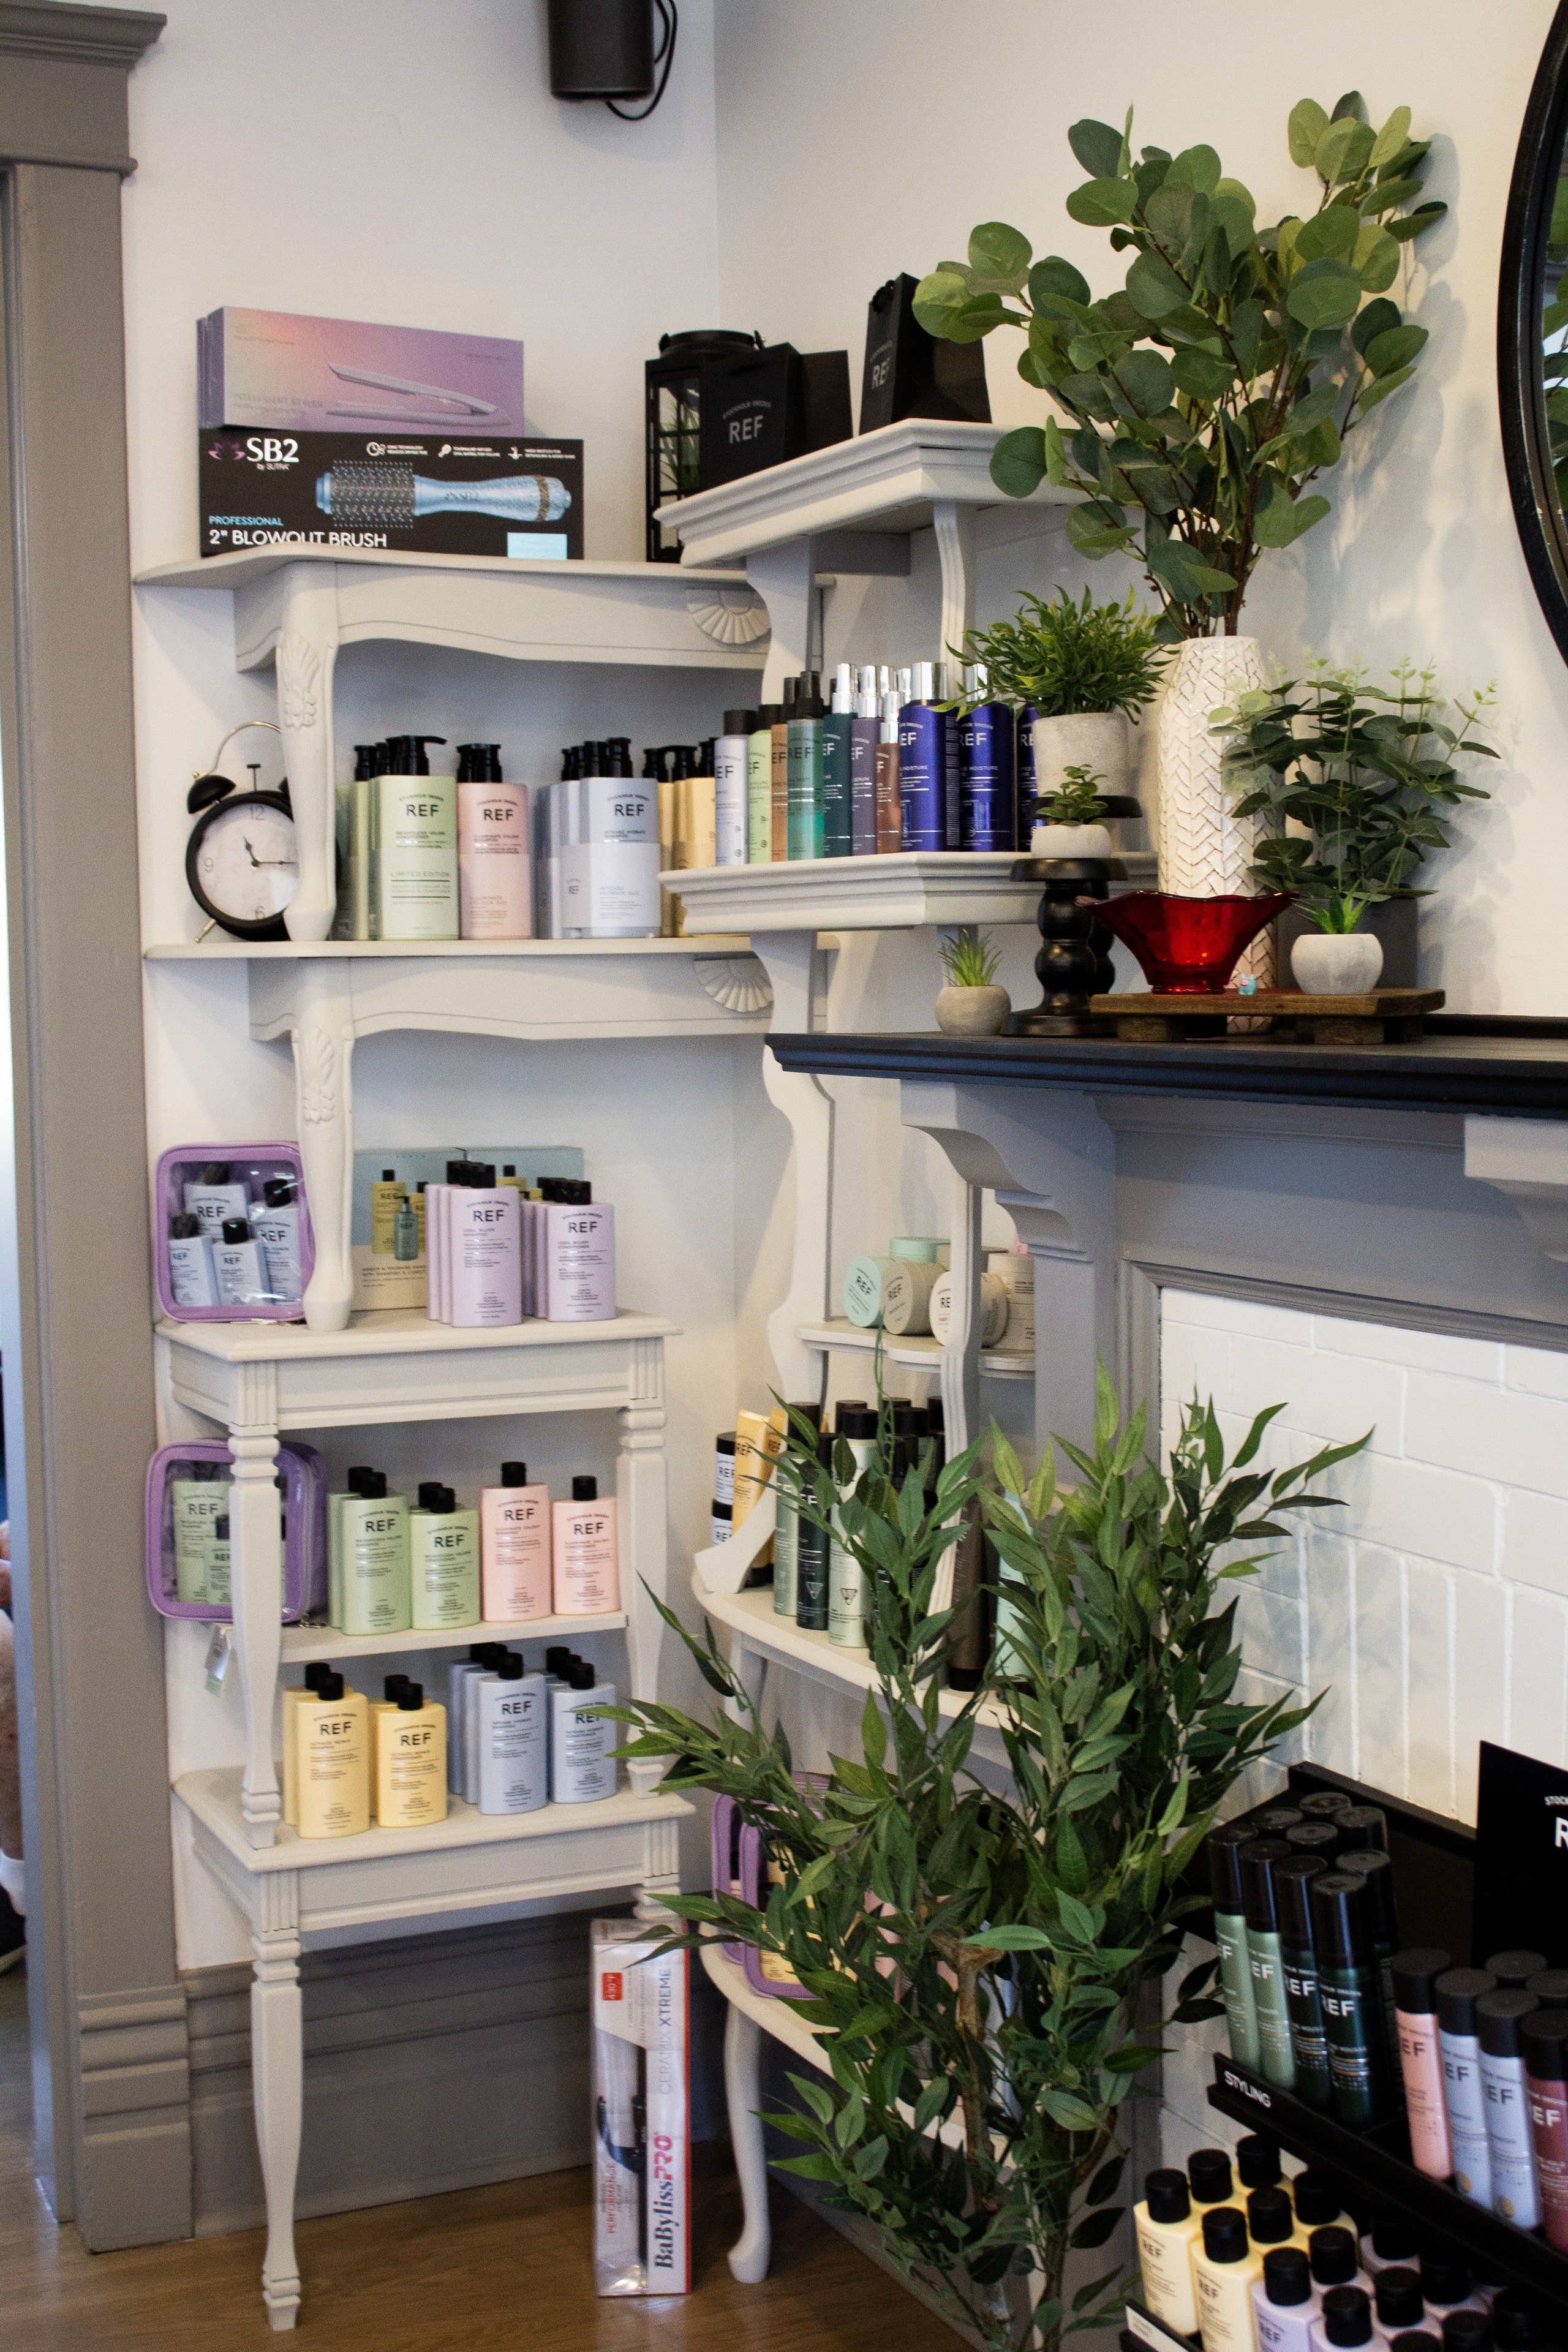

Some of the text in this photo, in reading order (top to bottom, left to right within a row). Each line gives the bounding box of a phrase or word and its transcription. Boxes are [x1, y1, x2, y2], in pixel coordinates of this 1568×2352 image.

[729, 415, 764, 444] REF
[246, 437, 300, 462] SB2
[208, 515, 284, 527] PROFESSIONAL
[232, 530, 326, 545] BLOWOUT
[328, 532, 388, 548] BRUSH
[900, 731, 918, 746] EF
[1019, 733, 1035, 747] RE
[772, 752, 786, 764] EF
[715, 765, 734, 779] EF
[405, 804, 440, 817] REF
[483, 809, 513, 821] REF
[614, 804, 645, 816] REF
[196, 1205, 225, 1218] REF
[472, 1209, 505, 1223] REF
[568, 1221, 598, 1234] REF
[259, 1229, 287, 1242] REF
[223, 1256, 242, 1265] REF
[940, 1296, 951, 1308] RE
[187, 1502, 219, 1515] REF
[504, 1507, 535, 1521] REF
[365, 1518, 396, 1532] REF
[573, 1521, 605, 1535] REF
[434, 1534, 465, 1548] REF
[501, 1700, 532, 1714] REF
[575, 1713, 600, 1724] RE
[320, 1721, 352, 1735] REF
[400, 1732, 432, 1746] REF
[1250, 1960, 1275, 1980] EF
[1289, 1978, 1316, 1997] EF
[657, 1967, 673, 2027] XTREME
[1401, 2038, 1425, 2057] EF
[1444, 2060, 1470, 2082] EF
[1224, 2070, 1272, 2109] STYLING
[1488, 2084, 1513, 2105] EF
[1532, 2105, 1561, 2128] EF
